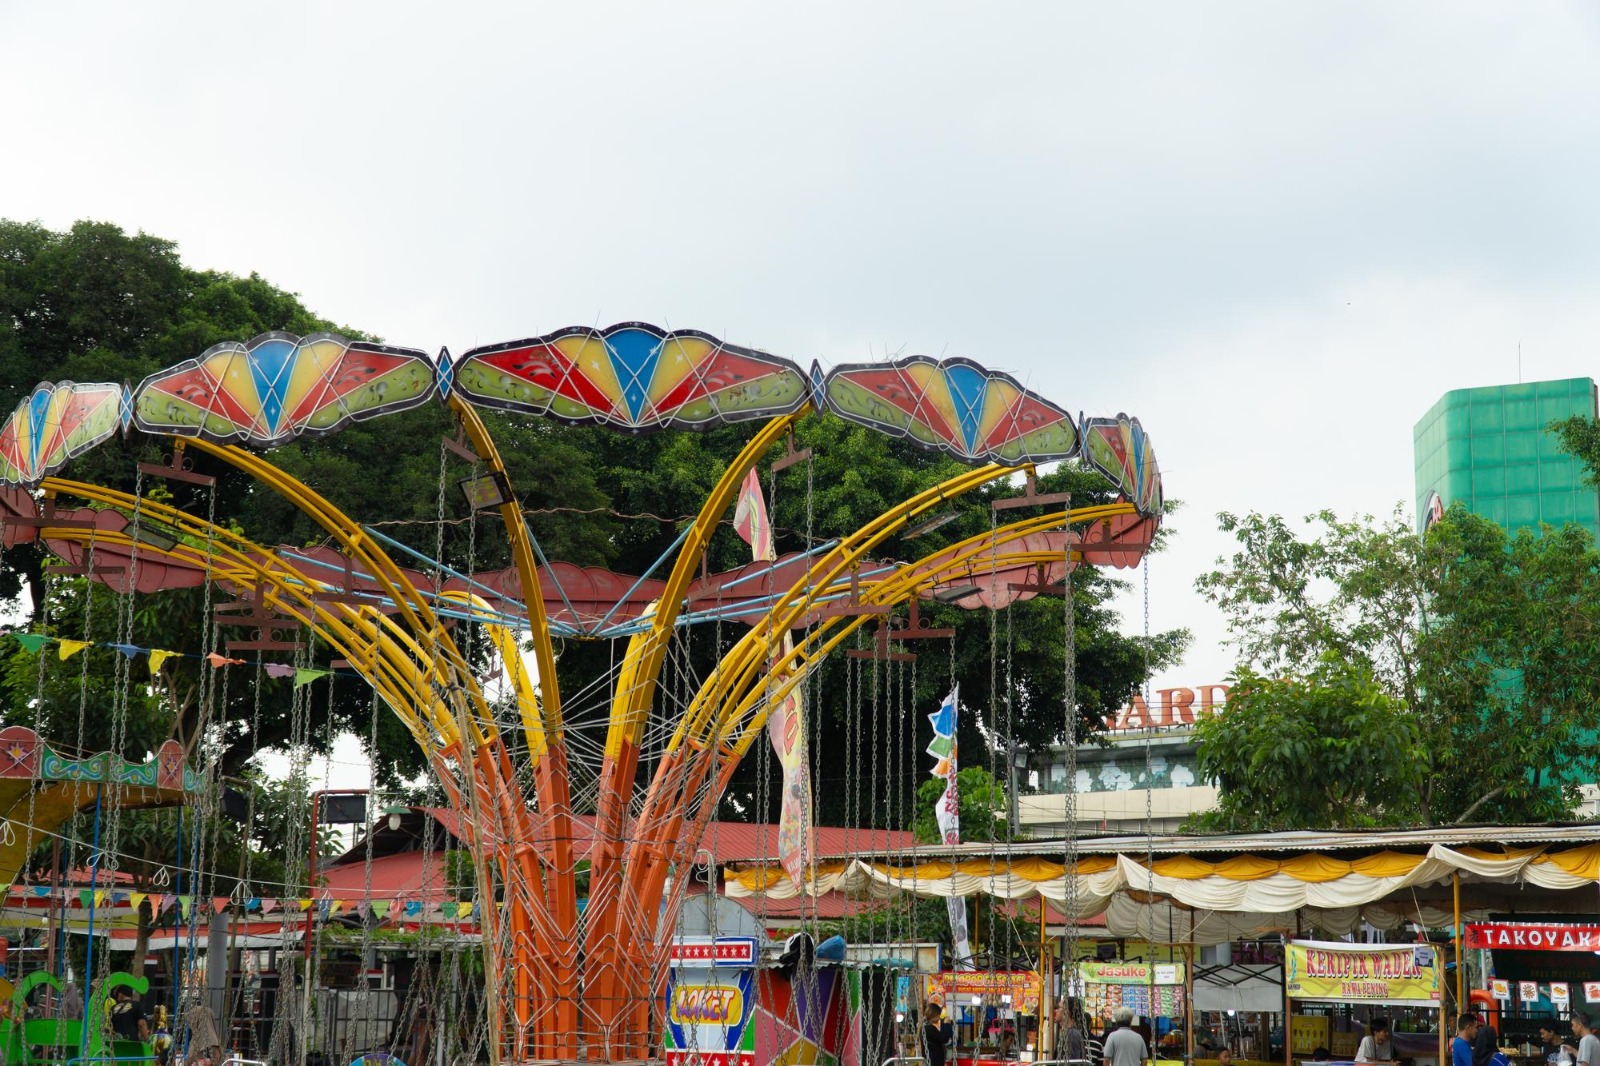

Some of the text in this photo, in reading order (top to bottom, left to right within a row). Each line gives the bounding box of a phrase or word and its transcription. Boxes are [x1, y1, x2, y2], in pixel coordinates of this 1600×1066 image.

[1097, 965, 1147, 977] Jasuke
[1306, 949, 1369, 978] KERIPIK
[1341, 982, 1388, 998] RAWA PENING
[676, 989, 735, 1020] LOKET
